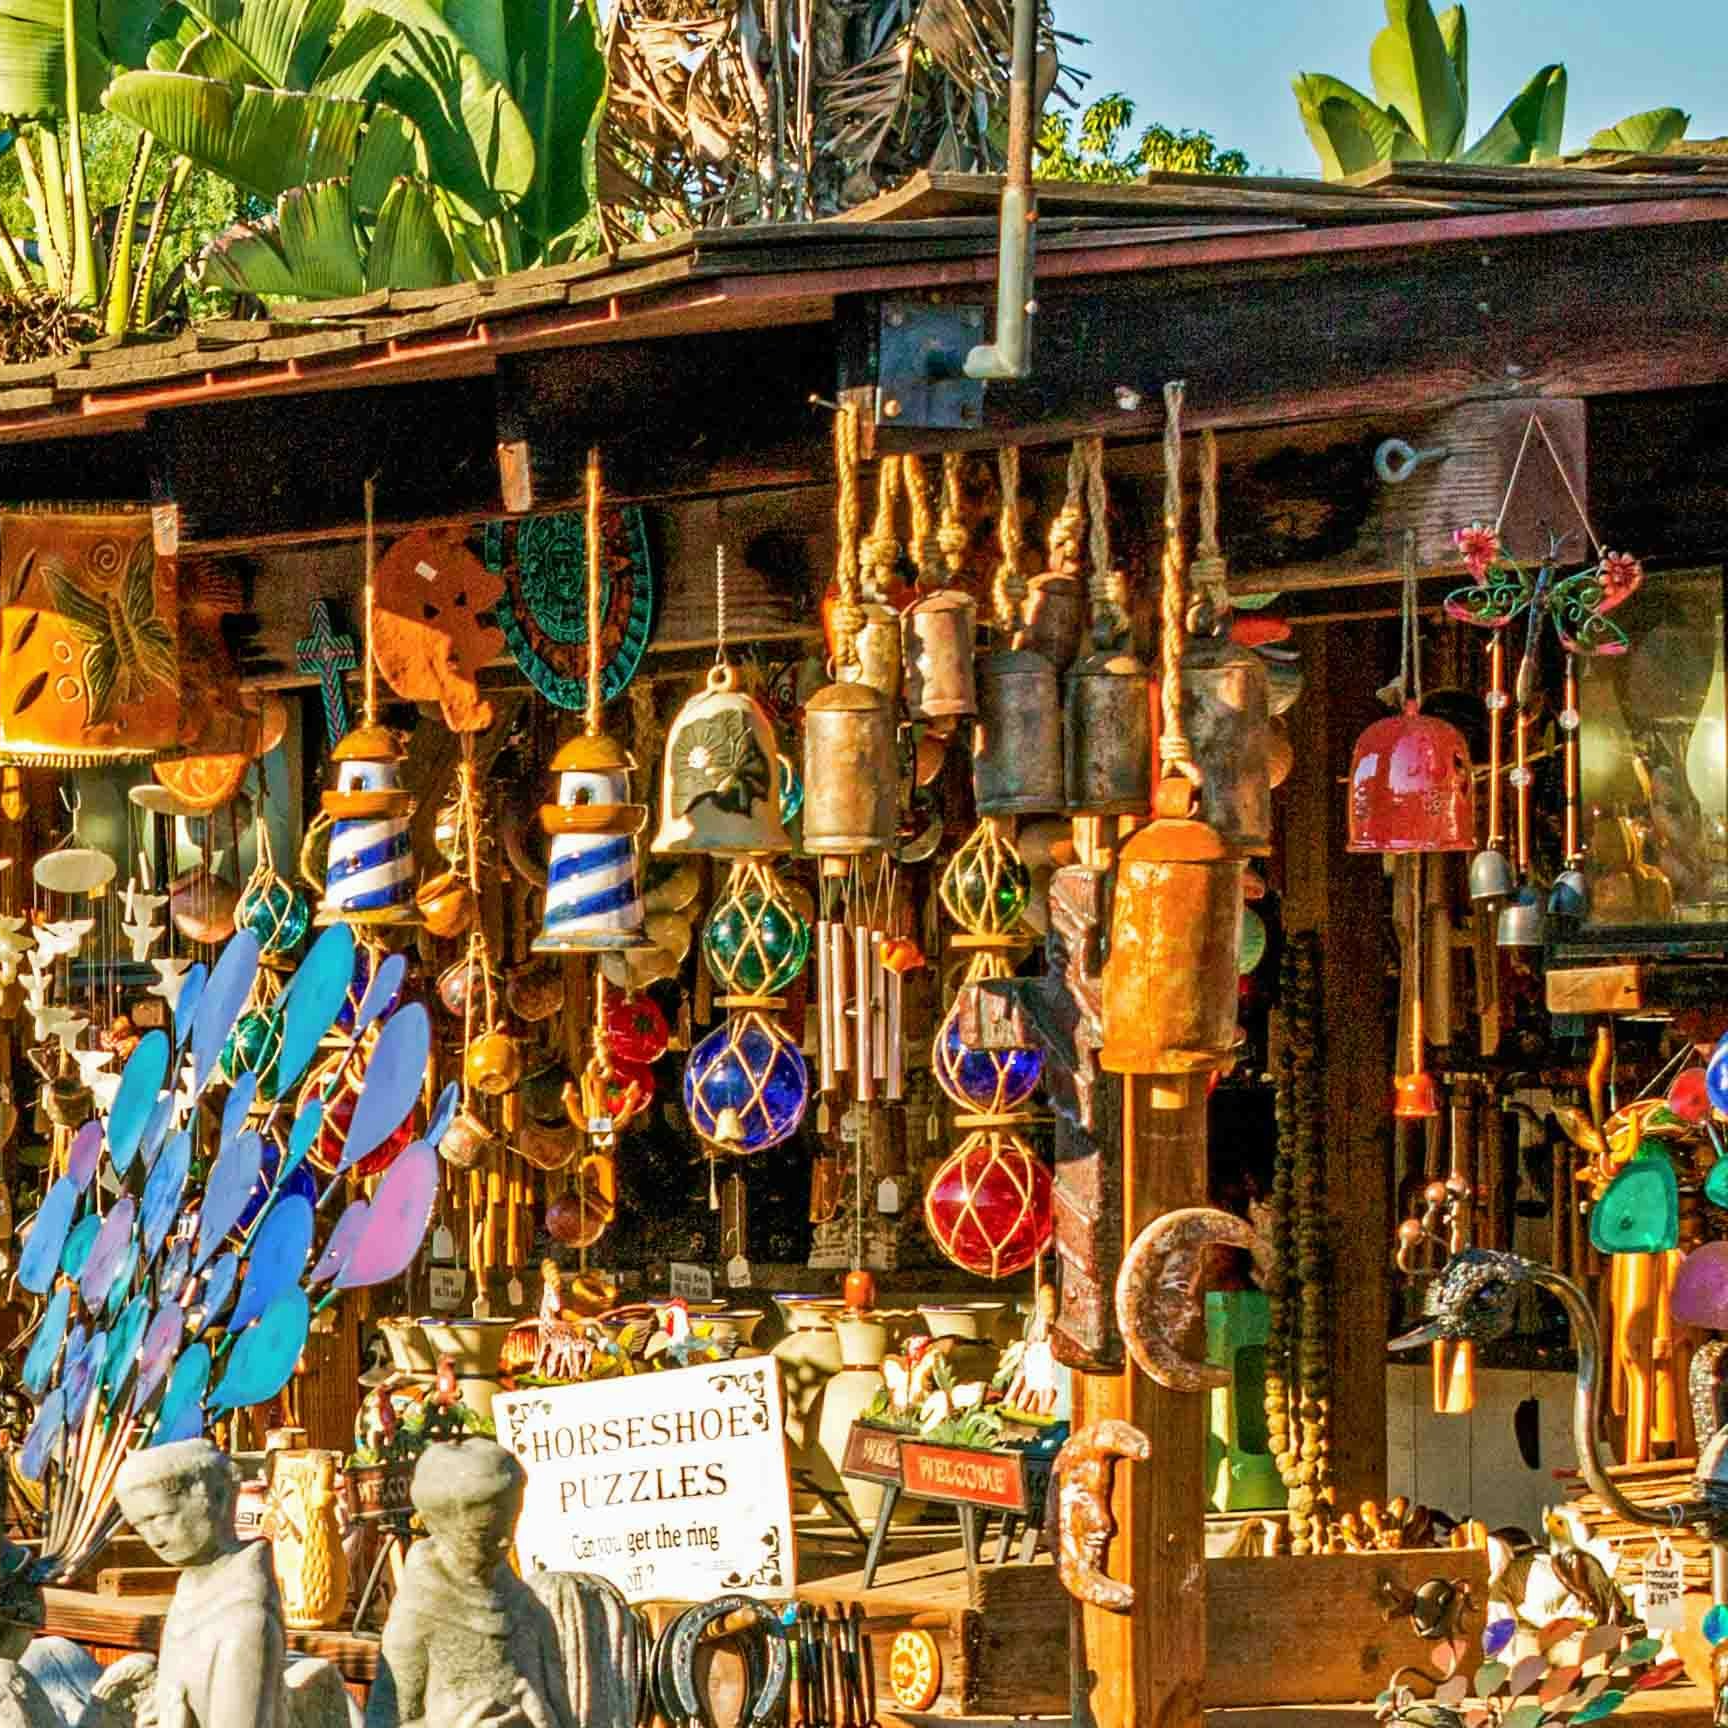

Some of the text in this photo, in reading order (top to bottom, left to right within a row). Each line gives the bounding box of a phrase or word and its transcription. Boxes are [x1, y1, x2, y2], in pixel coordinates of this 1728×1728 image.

[532, 1404, 750, 1463] HORSESHOE
[559, 1462, 729, 1513] PUZZLES
[919, 1454, 1008, 1495] WELCOME
[627, 1529, 651, 1557] get
[656, 1523, 682, 1549] the
[687, 1521, 720, 1551] ring
